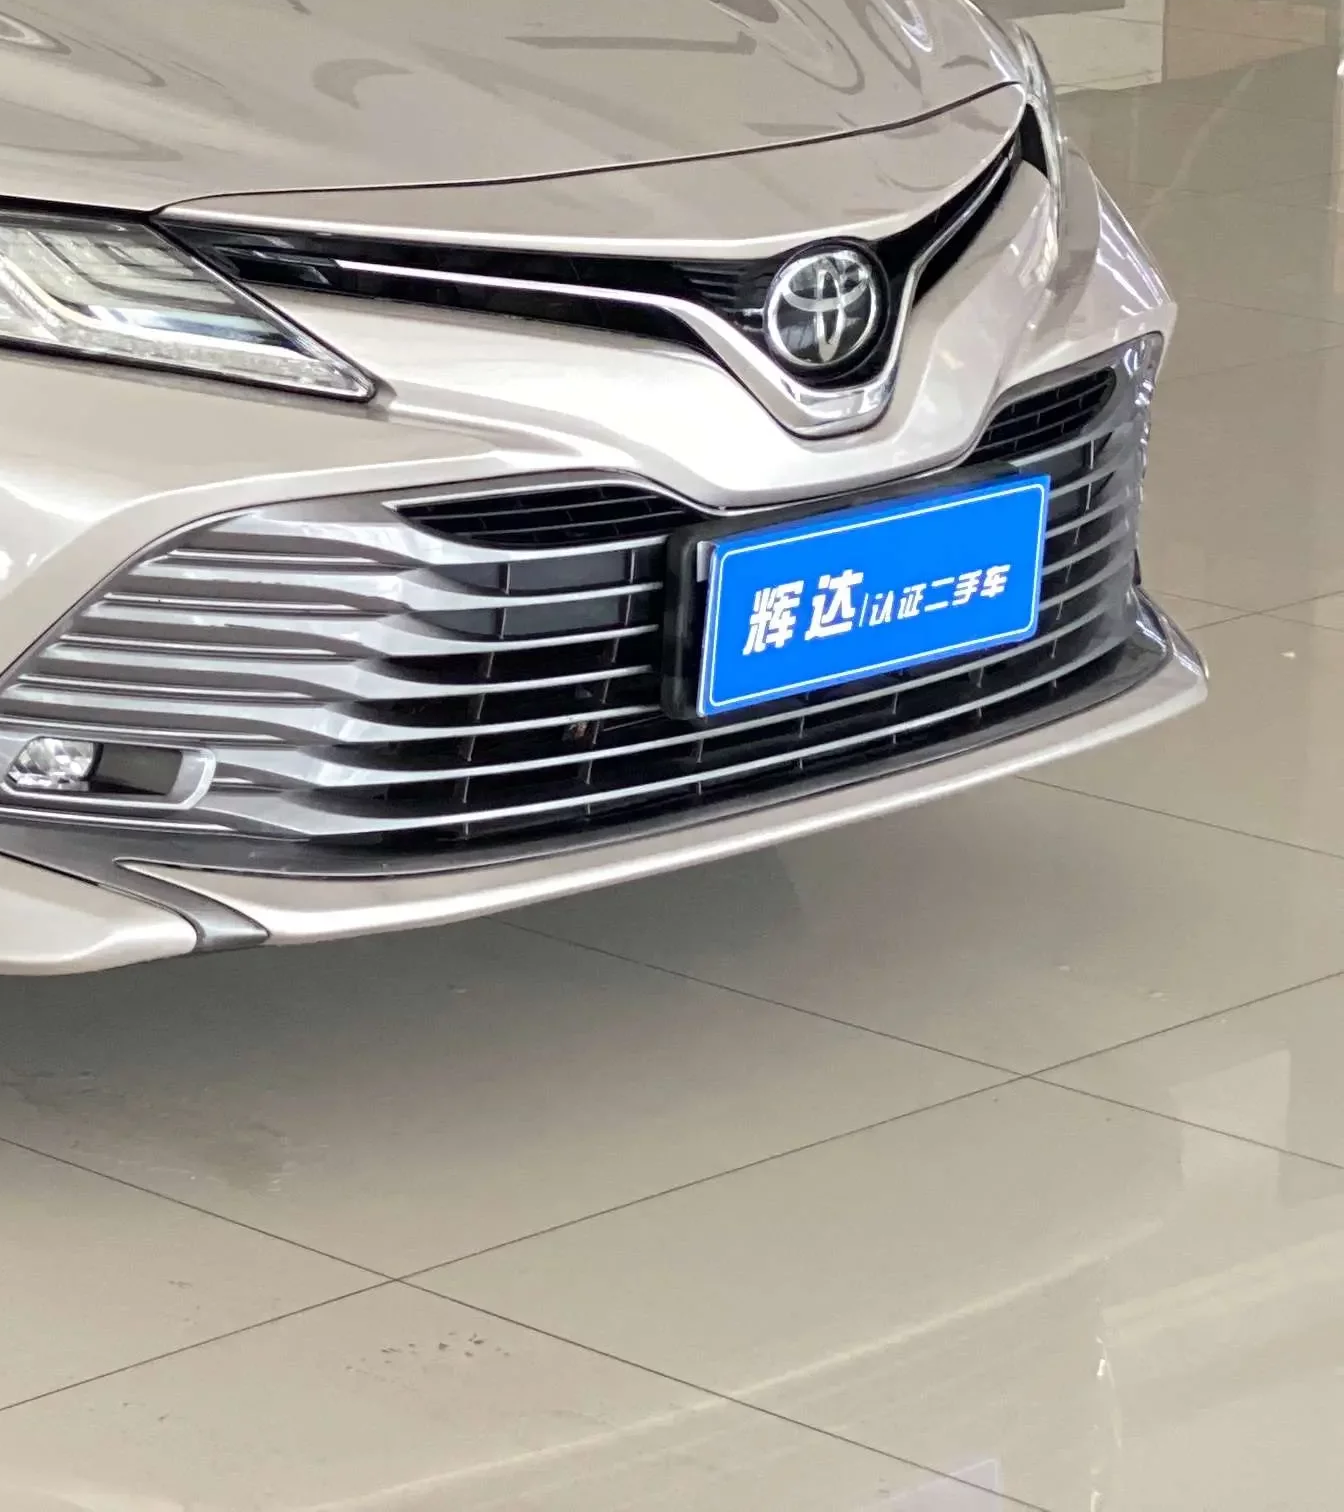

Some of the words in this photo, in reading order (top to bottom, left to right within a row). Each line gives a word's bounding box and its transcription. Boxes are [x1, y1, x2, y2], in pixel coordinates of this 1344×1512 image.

[741, 568, 865, 656] 辉达
[868, 564, 1011, 627] 认证二手车
